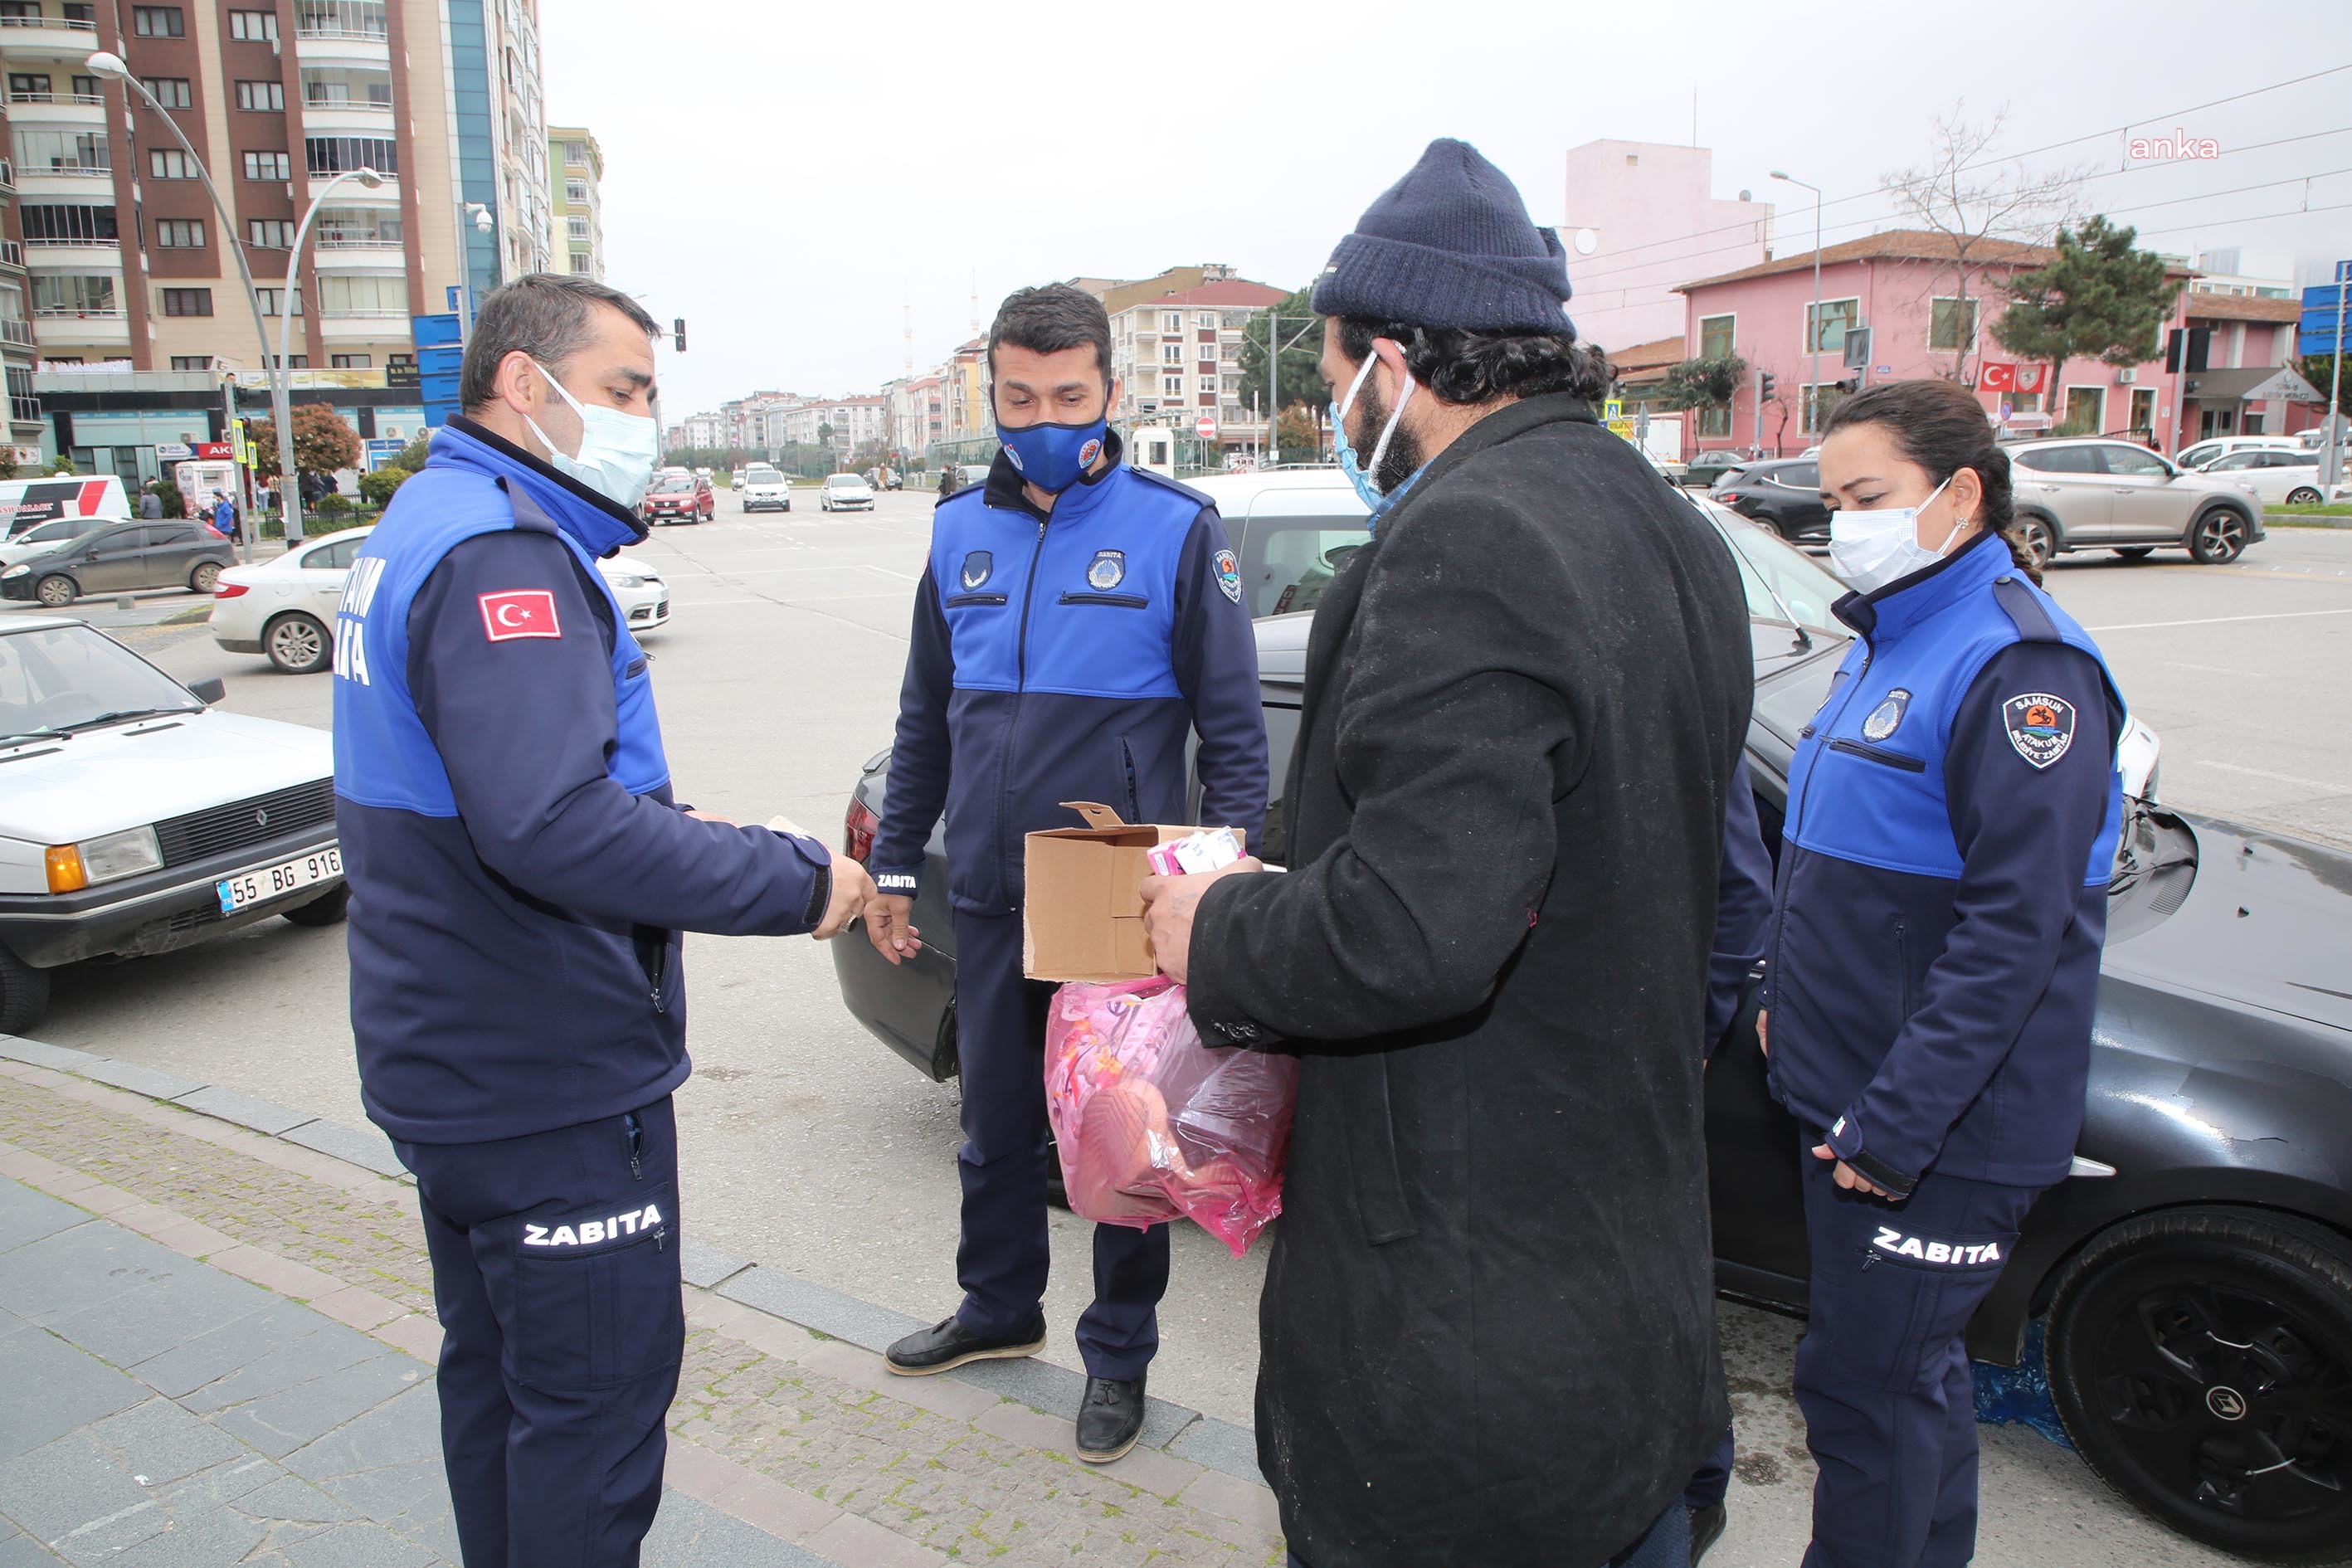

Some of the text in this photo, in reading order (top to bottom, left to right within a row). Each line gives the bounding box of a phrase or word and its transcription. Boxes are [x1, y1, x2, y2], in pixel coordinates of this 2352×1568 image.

[209, 446, 233, 455] AK
[2015, 697, 2064, 713] SAMSUN
[2022, 733, 2061, 748] ATAKUM
[233, 851, 340, 903] 55 BG 916
[878, 874, 917, 889] ZABITA
[523, 1204, 662, 1246] ZABITA
[1872, 1225, 2002, 1264] ZABITA
